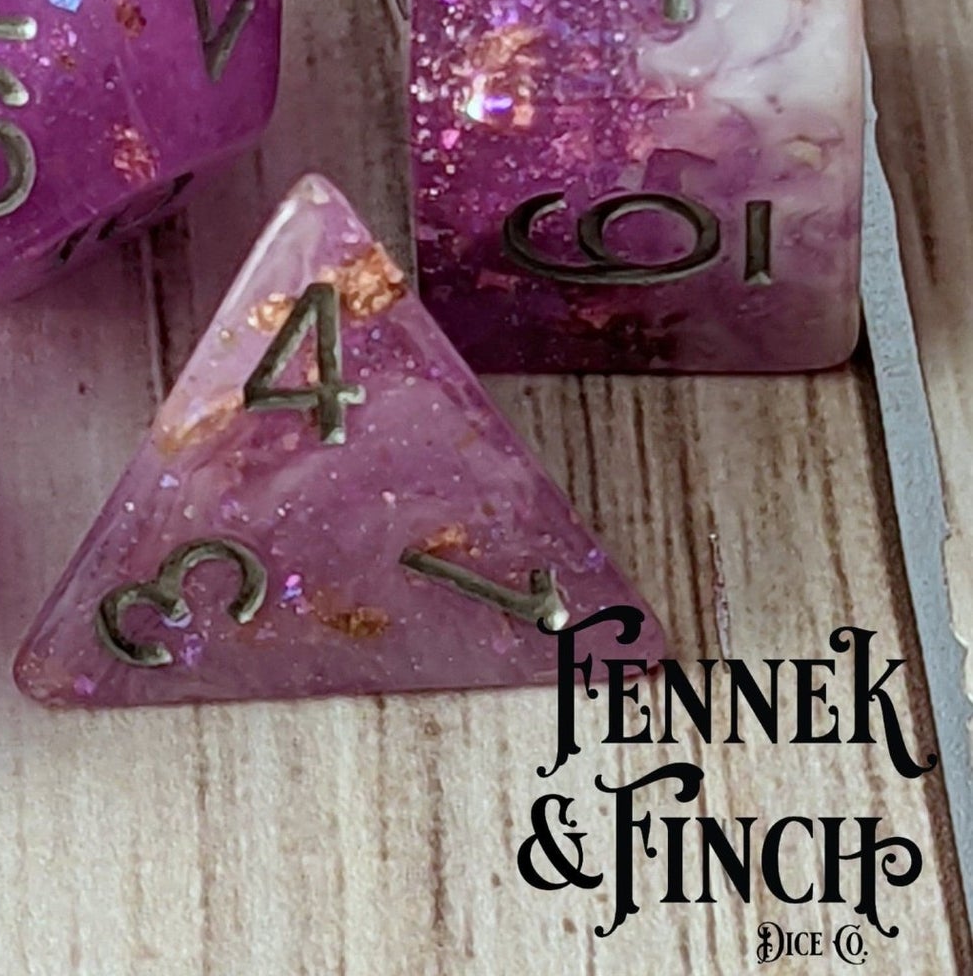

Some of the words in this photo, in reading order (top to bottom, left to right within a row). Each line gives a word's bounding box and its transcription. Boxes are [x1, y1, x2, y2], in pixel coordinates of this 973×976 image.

[244, 282, 366, 445] 4
[98, 537, 267, 667] 3
[400, 546, 572, 632] 1
